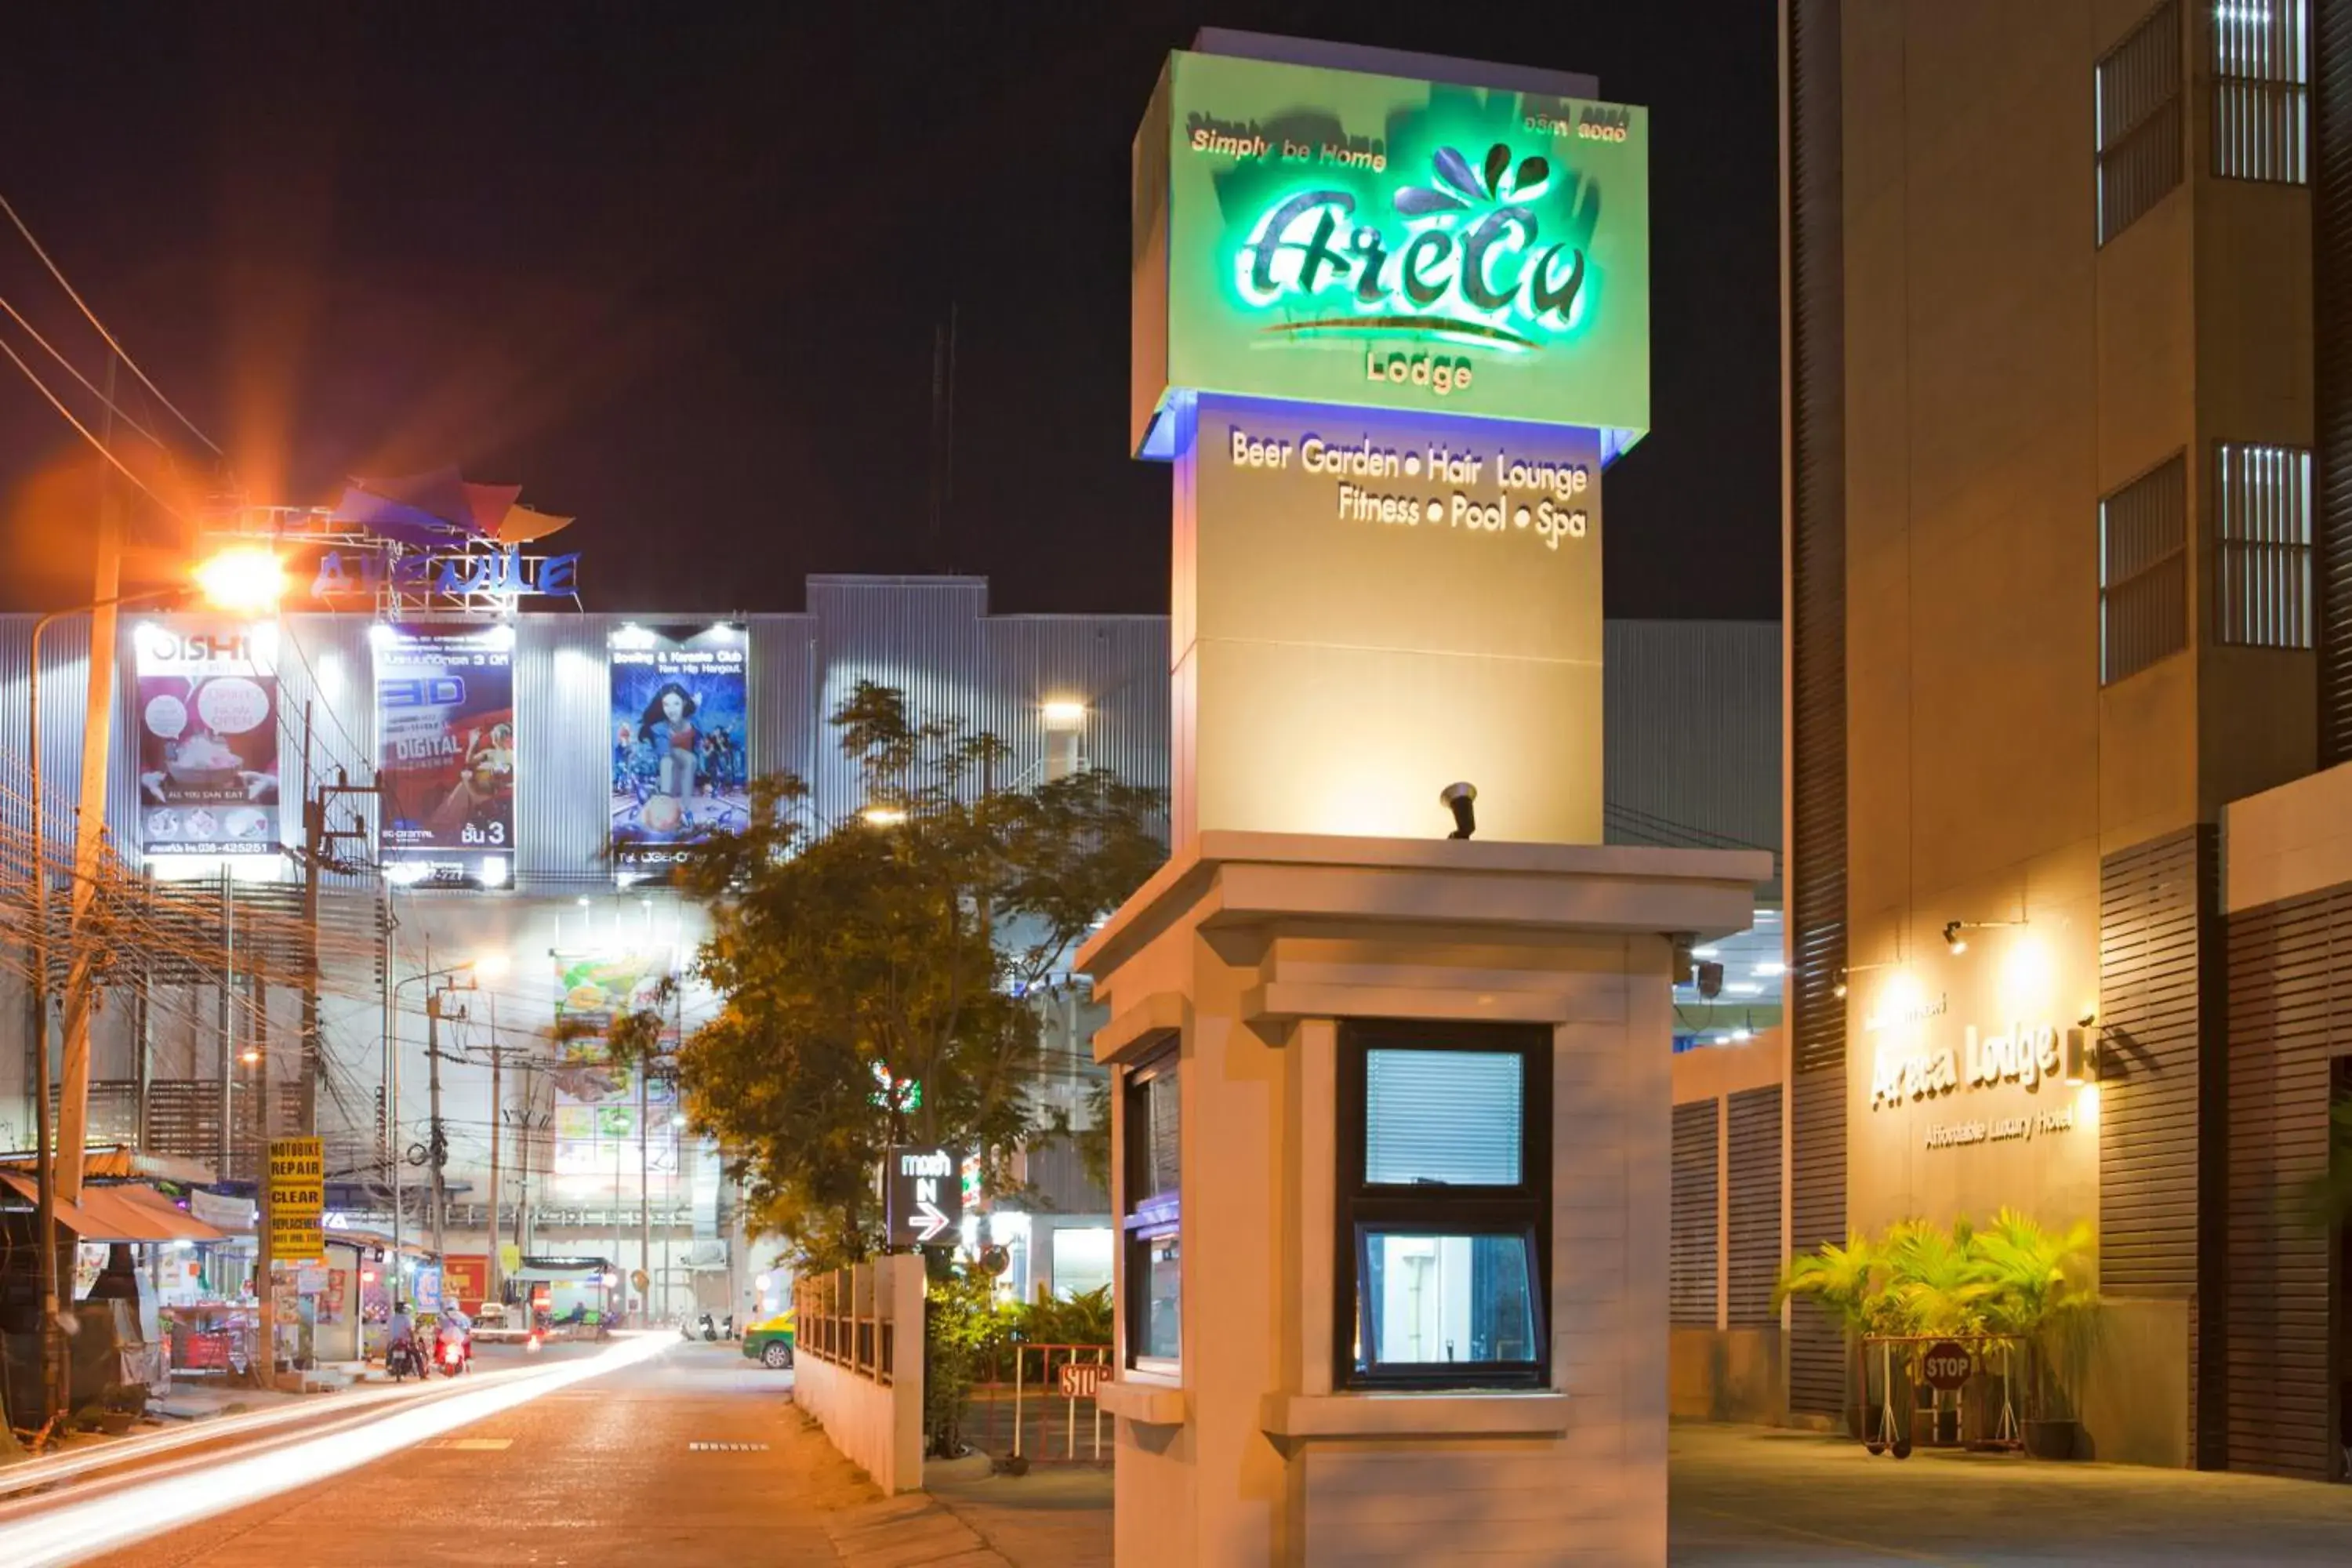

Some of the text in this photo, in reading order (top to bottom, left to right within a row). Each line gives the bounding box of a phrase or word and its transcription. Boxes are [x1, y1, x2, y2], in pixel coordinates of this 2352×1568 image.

[1191, 128, 1387, 173] Simply be Home
[1367, 352, 1473, 396] Lodge
[1232, 430, 1588, 501] Beer Garden Hair Lounge
[1339, 484, 1587, 550] Fitness Pool Spa
[717, 651, 742, 662] Club
[396, 735, 463, 760] DIGITAL
[461, 821, 504, 844] ชั้น 3
[1964, 1022, 2060, 1088] Lodge
[271, 1142, 320, 1157] MOTOBIKE
[272, 1161, 320, 1175] REPAIR
[272, 1191, 318, 1203] CLEAR
[1926, 1356, 1969, 1377] STOP
[1063, 1366, 1110, 1395] STOP
